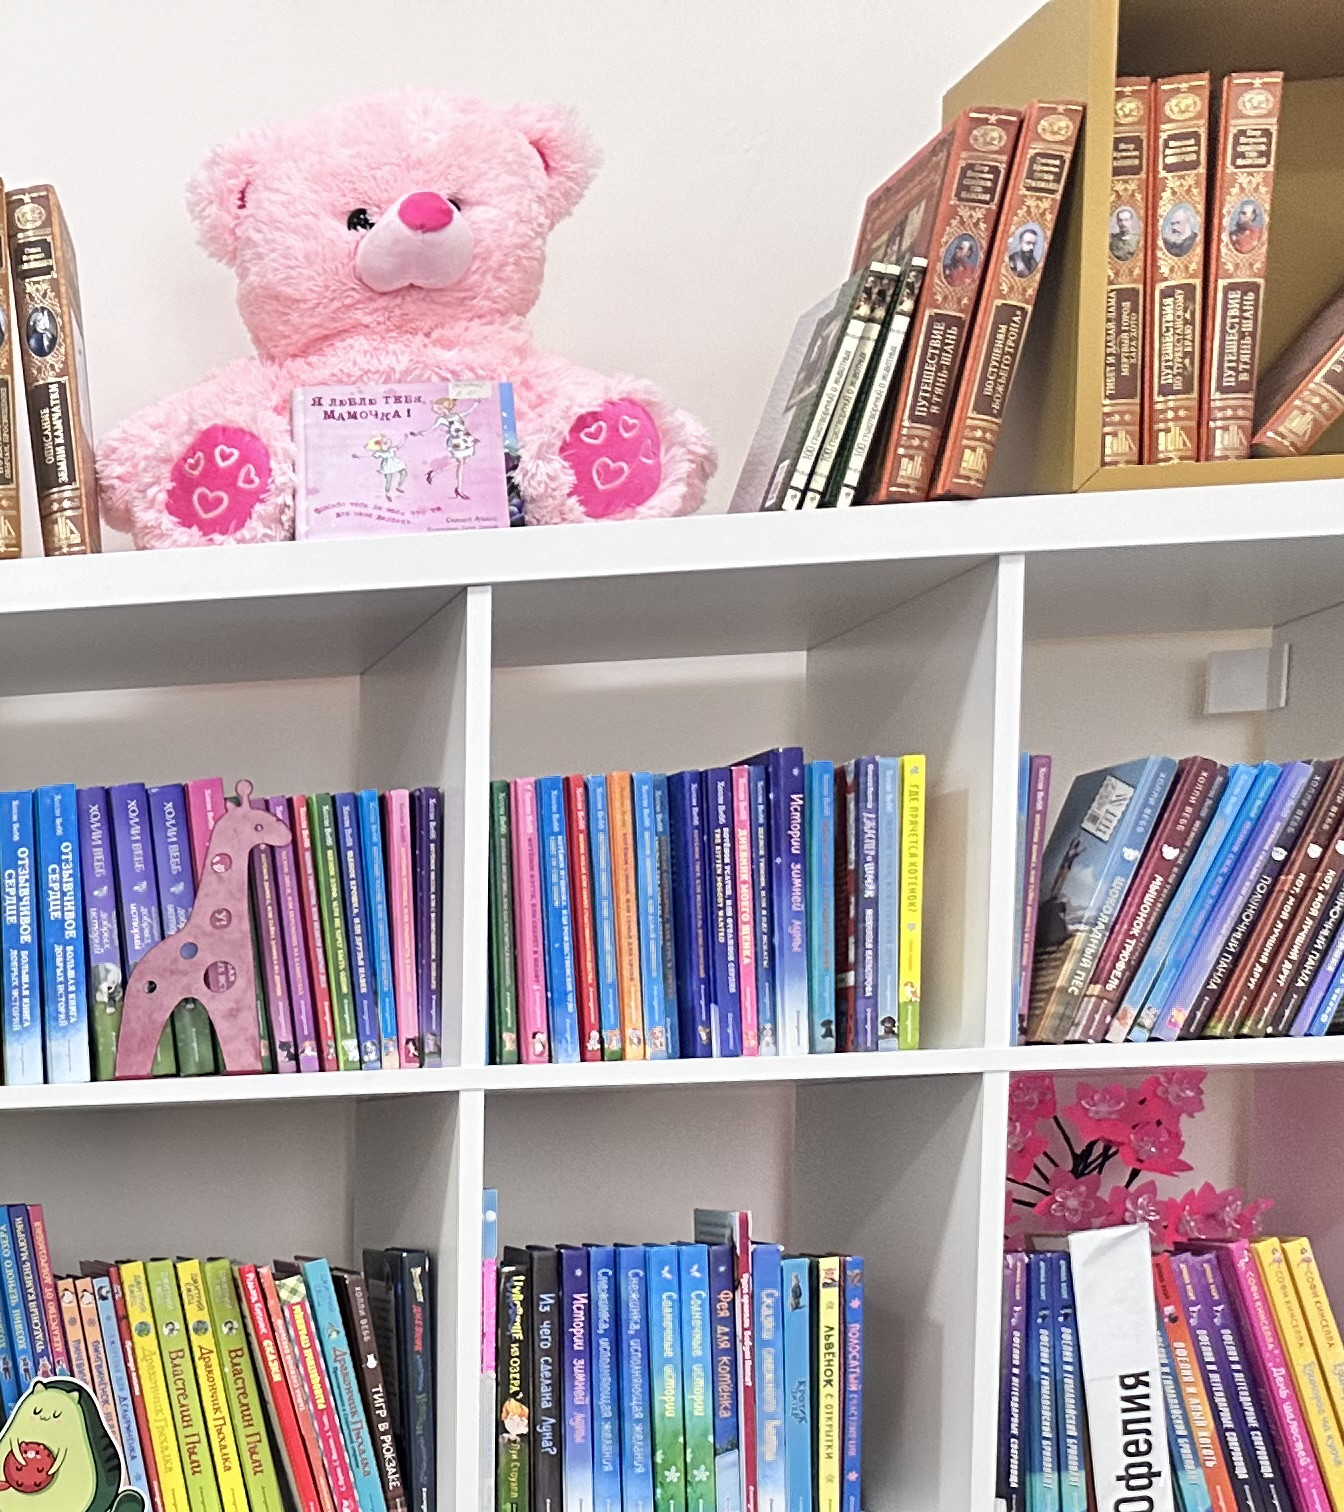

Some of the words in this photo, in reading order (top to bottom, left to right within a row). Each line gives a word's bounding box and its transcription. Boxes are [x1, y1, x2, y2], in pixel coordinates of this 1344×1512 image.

[915, 323, 945, 416] ПУТЕШЕСТВИЕ
[48, 384, 65, 443] КАМЧАТКИ
[311, 397, 322, 406] Я
[40, 408, 54, 463] ОПИСАНИЕ
[802, 447, 815, 459] 100
[855, 444, 868, 457] 100
[54, 446, 68, 483] ЗЕМЛИ
[907, 784, 918, 803] ГДЕ
[89, 804, 103, 844] ХОЛЛИ
[907, 806, 918, 859] ПРЯЧЕТСЯ
[92, 848, 105, 877] ВЕББ
[48, 864, 60, 920] СЕРДЦЕ
[60, 841, 76, 939] ОТЗЫВЧИВОЕ
[1130, 874, 1164, 936] МЫШОНОК
[1276, 896, 1296, 919] МОЙ
[1078, 876, 1126, 967] ШОКОЛАДНЫЙ
[1227, 876, 1271, 952] ПОЛУНОЧНЫЙ
[1106, 938, 1140, 991] ТРЮФЕЛЬ
[1258, 922, 1285, 964] ЛУЧШИЙ
[66, 946, 76, 990] БОЛЬШАЯ
[1066, 970, 1088, 995] ПЁС
[1206, 953, 1233, 989] ПАНДА
[1246, 965, 1267, 989] ДРУГ
[68, 993, 77, 1023] КНИГА
[539, 1293, 555, 1311] Из
[569, 1293, 590, 1350] Истории
[715, 1291, 733, 1317] Фея
[538, 1320, 553, 1348] чего
[716, 1326, 732, 1349] для
[847, 1323, 861, 1389] ПОЛОСАТЫЙ
[197, 1345, 226, 1415] Дракончик
[228, 1349, 257, 1427] Властелин
[539, 1357, 554, 1408] сделана
[572, 1358, 590, 1405] зимней
[717, 1356, 735, 1418] котёнка
[1271, 1367, 1293, 1400] День
[210, 1417, 236, 1472] Пыхалка
[242, 1432, 268, 1476] Пыли
[370, 1384, 388, 1417] ТИГР
[380, 1434, 401, 1490] РЮКЗАКЕ
[538, 1416, 557, 1454] Луна?
